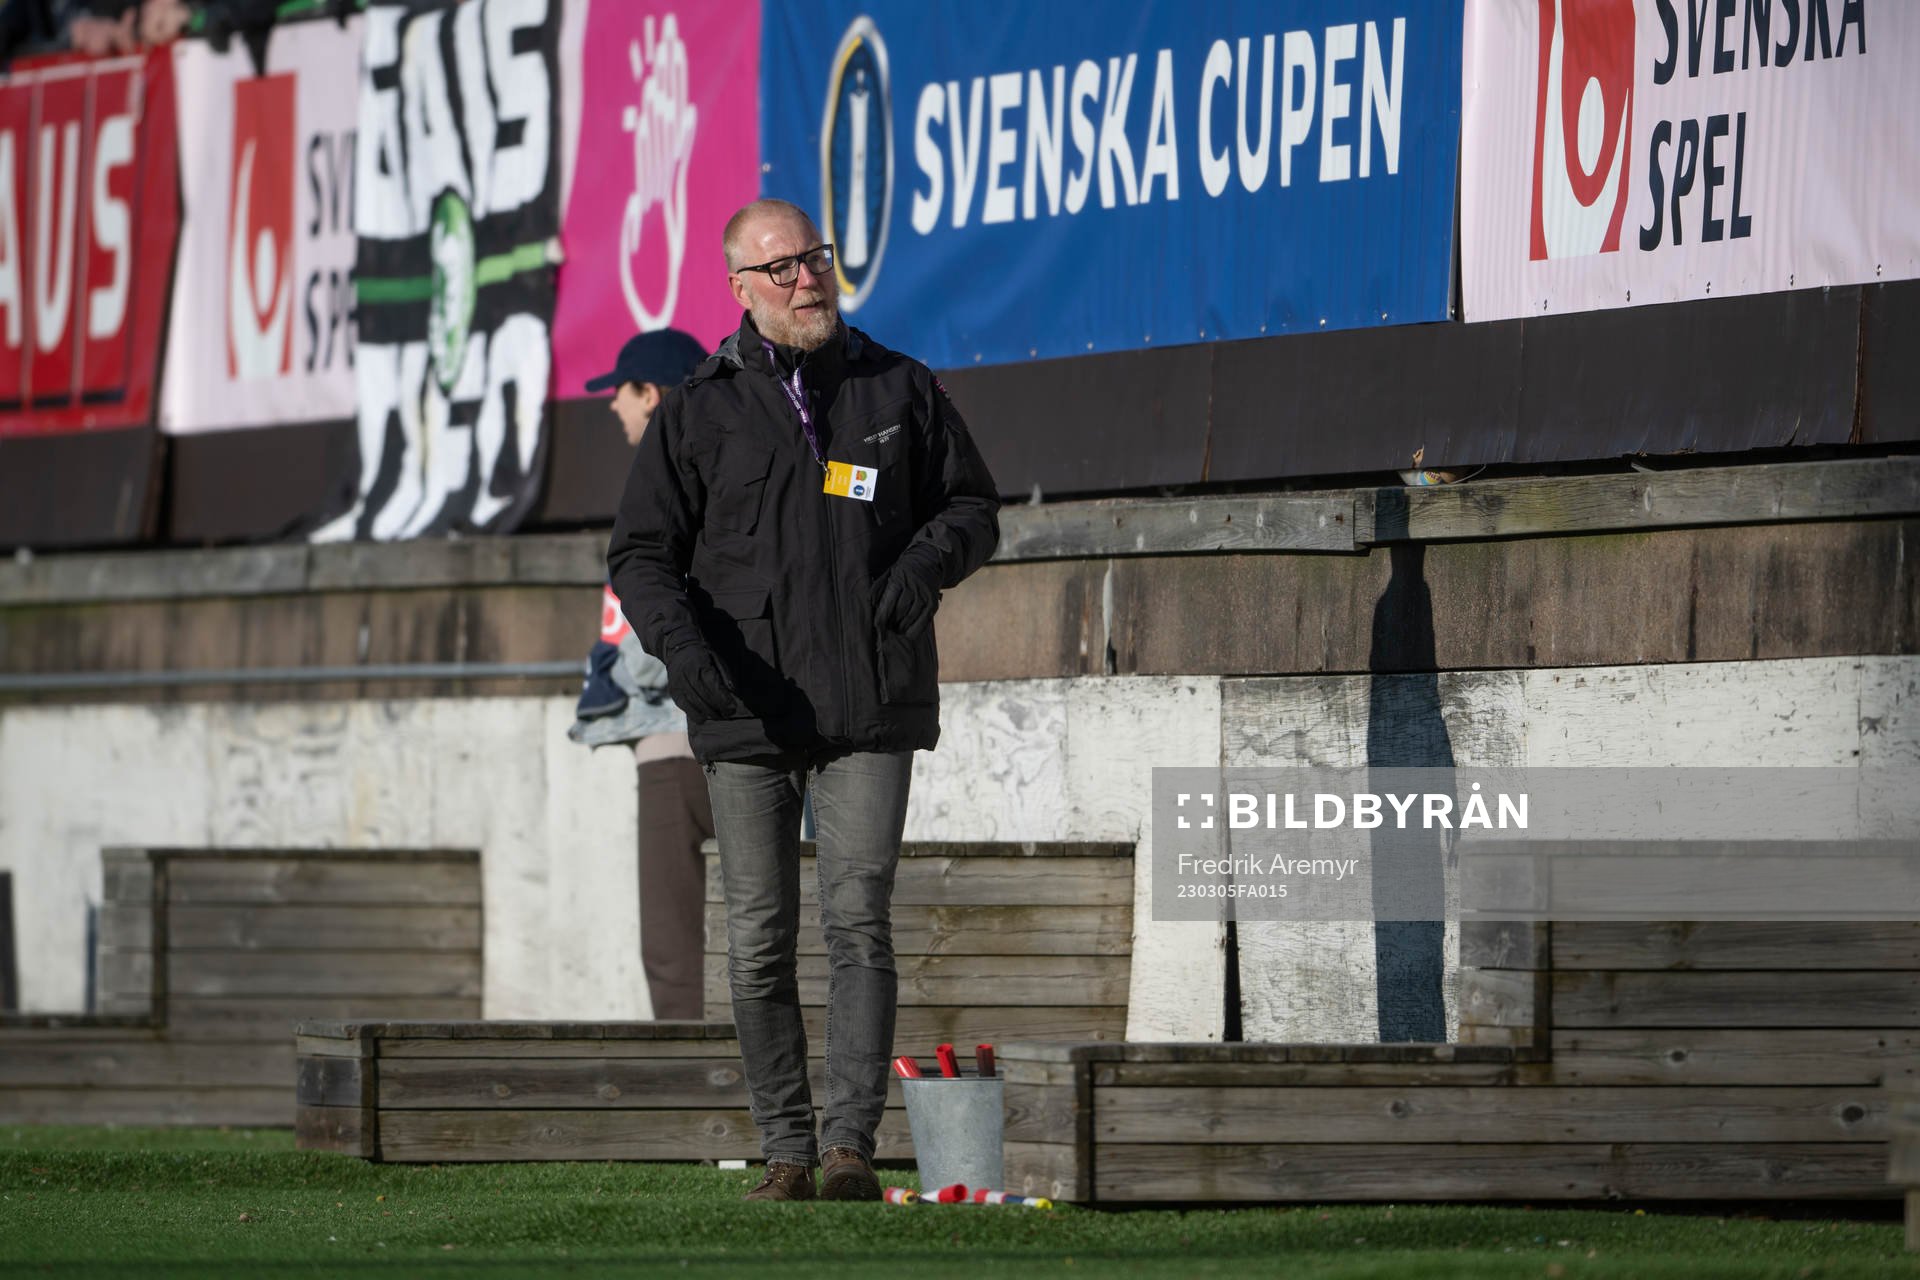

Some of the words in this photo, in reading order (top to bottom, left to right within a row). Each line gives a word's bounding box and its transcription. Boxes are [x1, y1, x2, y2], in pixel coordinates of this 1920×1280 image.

[911, 48, 1180, 236] SVENSKA
[1198, 16, 1407, 198] CUPEN
[1639, 111, 1752, 252] SPEL
